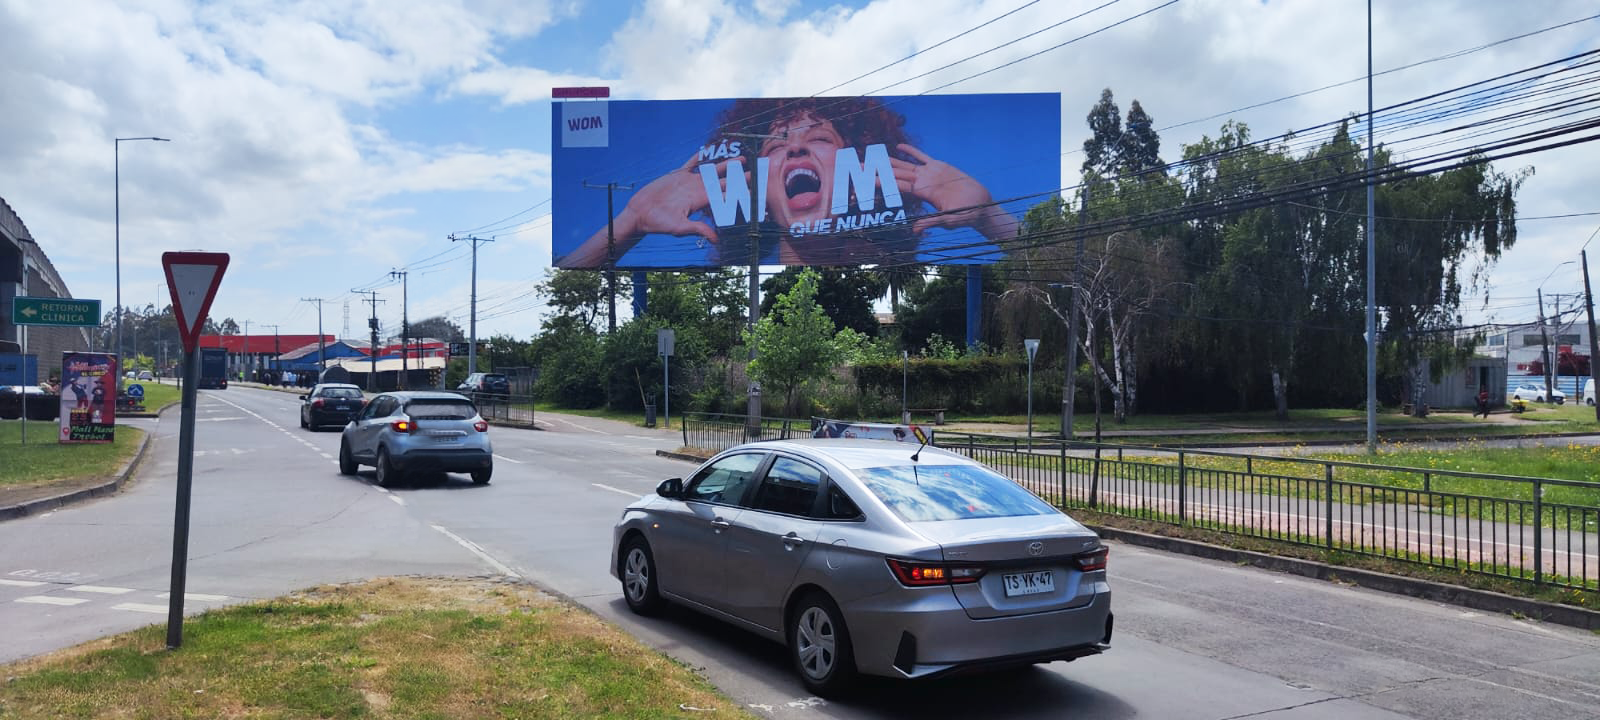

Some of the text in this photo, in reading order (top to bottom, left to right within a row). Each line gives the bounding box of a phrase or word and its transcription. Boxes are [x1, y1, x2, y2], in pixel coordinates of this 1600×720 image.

[567, 116, 603, 131] WOM
[699, 139, 742, 161] MÁS
[789, 209, 907, 238] QUE NUNCA
[41, 303, 88, 312] RETORNO
